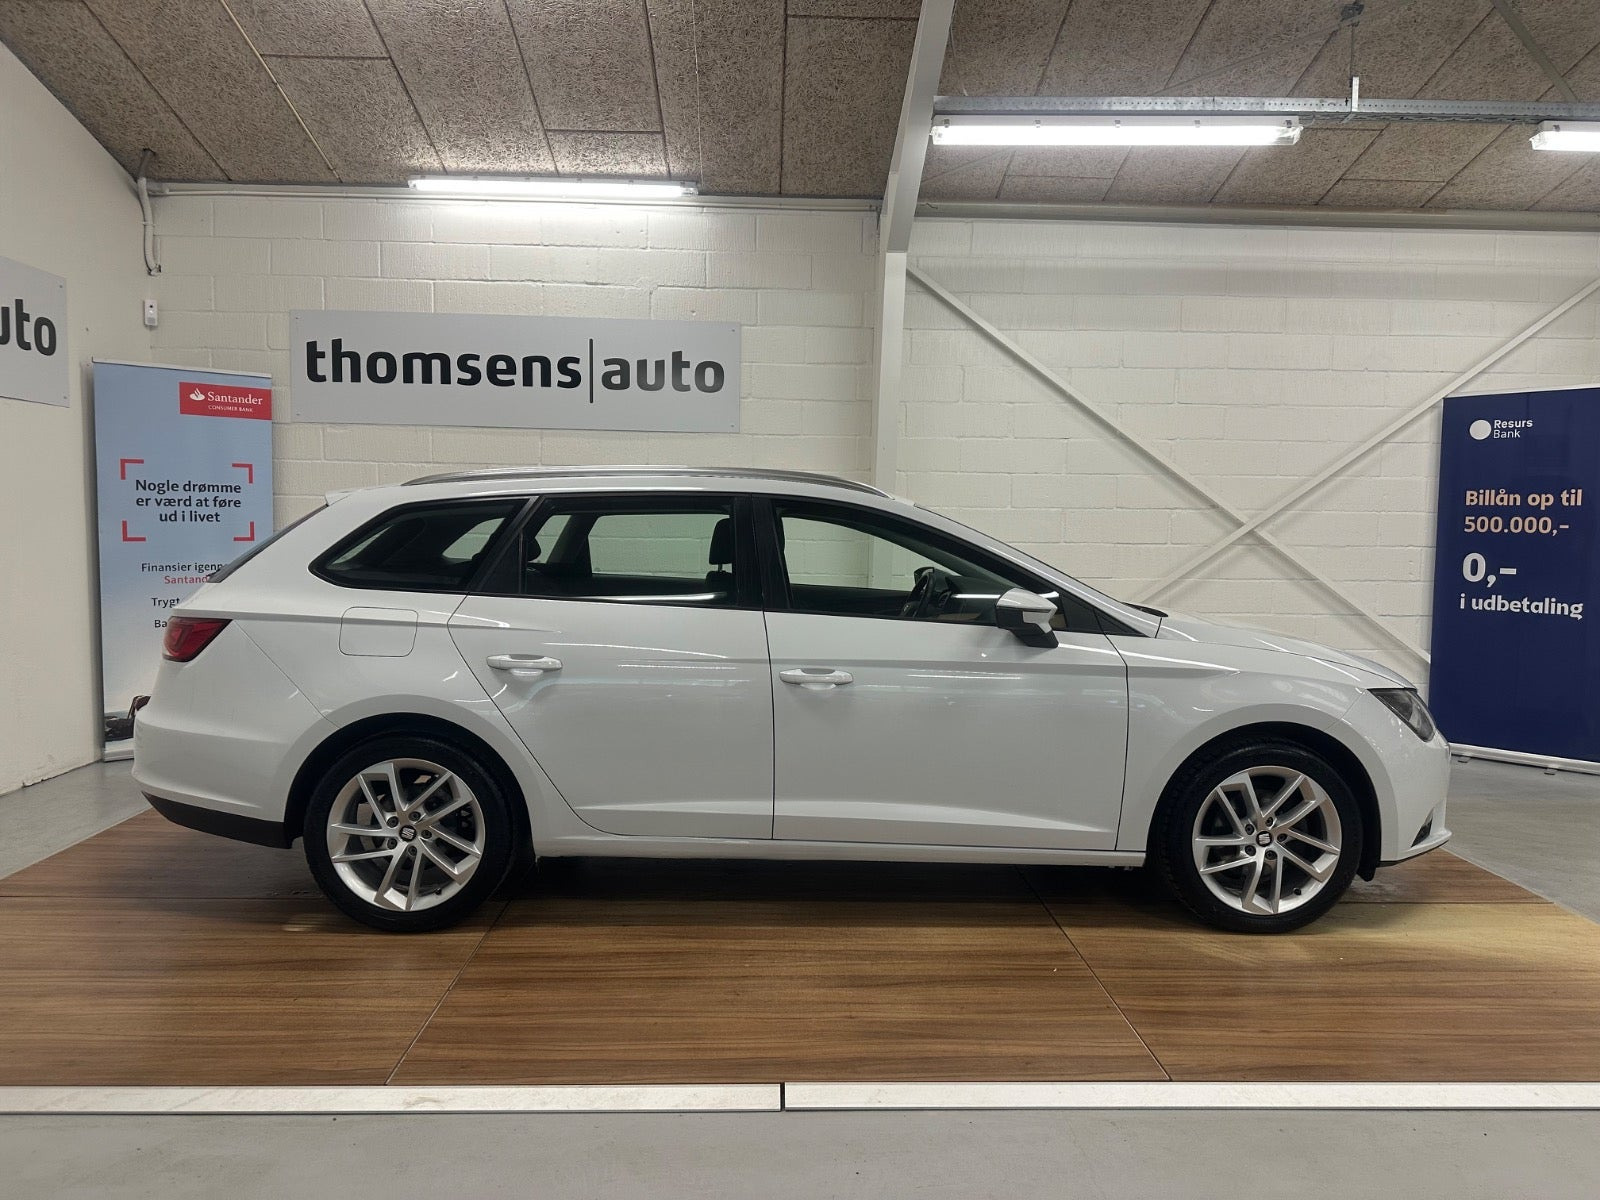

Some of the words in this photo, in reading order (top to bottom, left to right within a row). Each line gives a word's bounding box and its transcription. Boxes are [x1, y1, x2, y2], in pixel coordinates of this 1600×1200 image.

[305, 337, 582, 389] thomsens
[601, 350, 725, 393] auto
[207, 391, 263, 405] Santander
[1494, 419, 1533, 429] Resurs
[1493, 429, 1521, 439] Bank
[135, 479, 179, 495] Nogle
[183, 480, 242, 494] drømme
[136, 497, 151, 507] er
[154, 495, 192, 507] værd
[195, 496, 210, 508] at
[212, 495, 242, 508] føre
[1465, 488, 1521, 506] Billån
[1527, 492, 1554, 510] op
[1560, 489, 1583, 506] til
[159, 509, 178, 522] ud
[181, 510, 185, 522] i
[189, 510, 221, 522] livet
[141, 562, 192, 572] Finansier
[151, 597, 180, 609] Trygt
[1460, 593, 1466, 609] i
[1471, 595, 1584, 620] udbetaling
